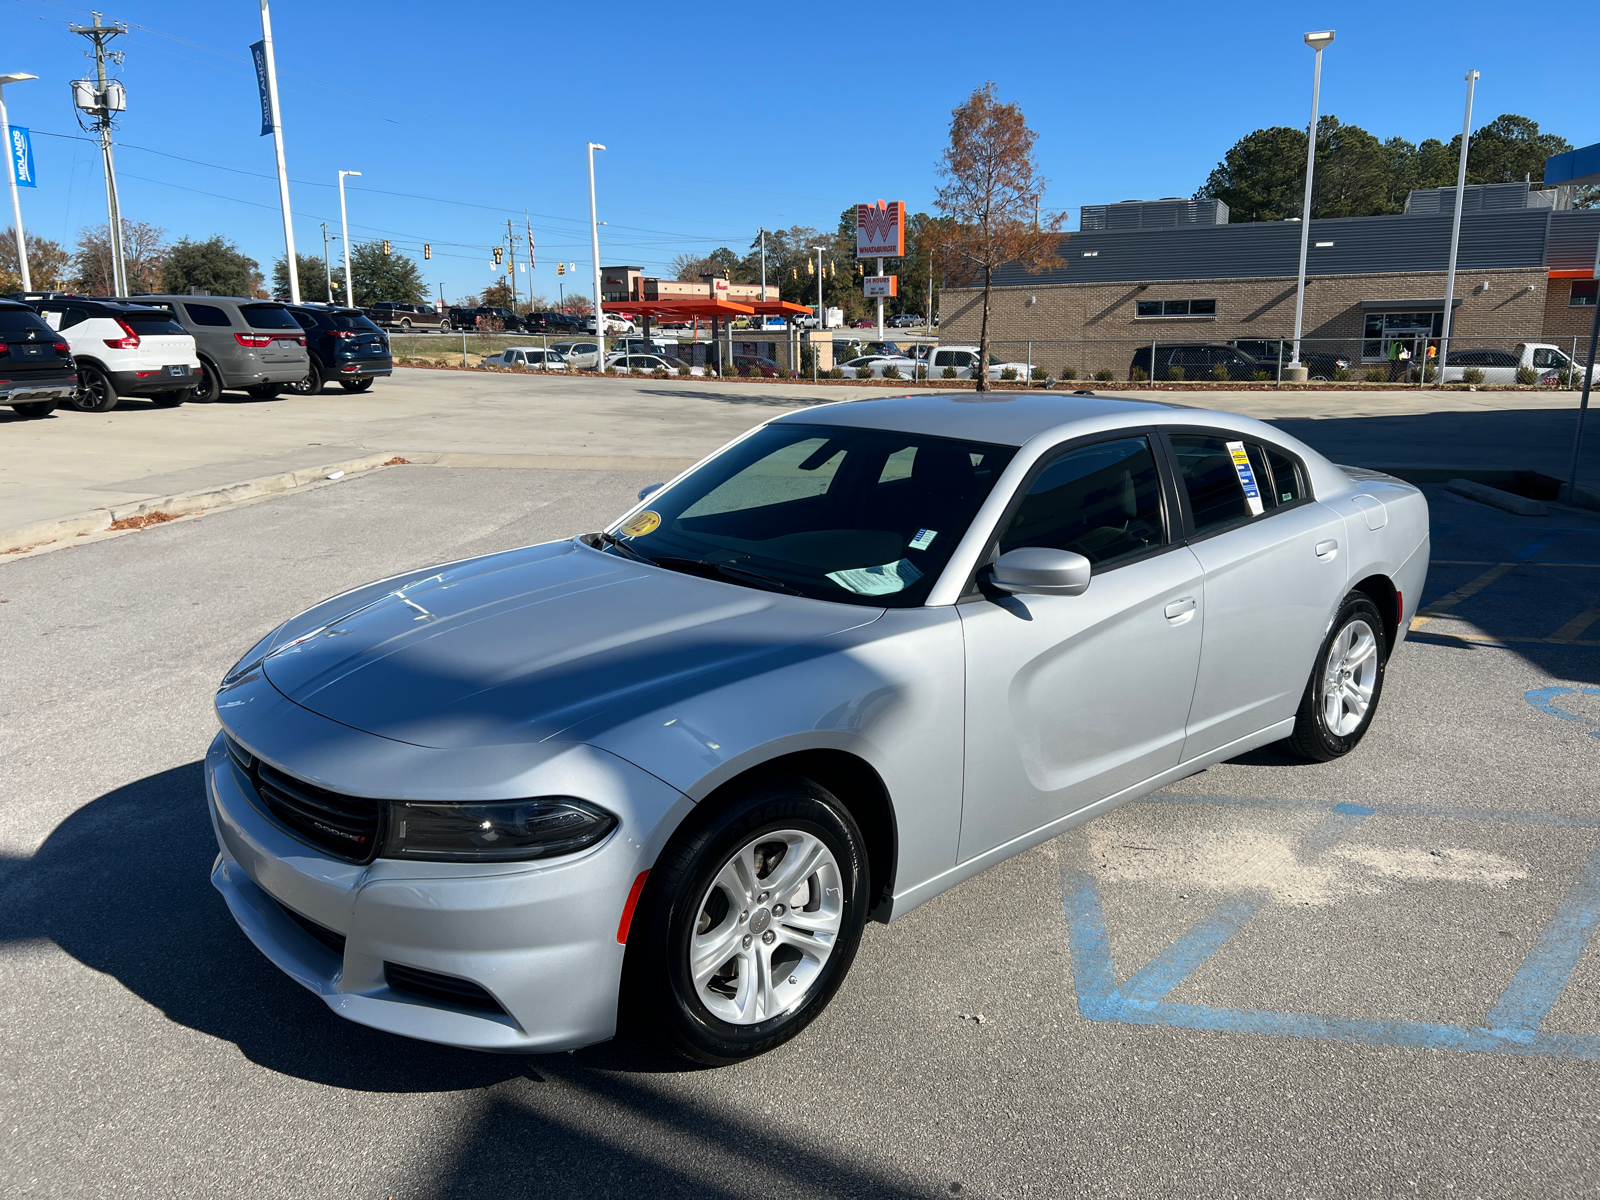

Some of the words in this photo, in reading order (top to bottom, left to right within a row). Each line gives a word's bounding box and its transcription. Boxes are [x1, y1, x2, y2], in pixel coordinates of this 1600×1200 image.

[255, 50, 270, 126] MIDLANDS
[12, 130, 27, 181] MIDLANDS
[859, 245, 897, 254] WHATABURGER
[749, 801, 821, 828] SAILUN
[314, 821, 358, 841] DODGE
